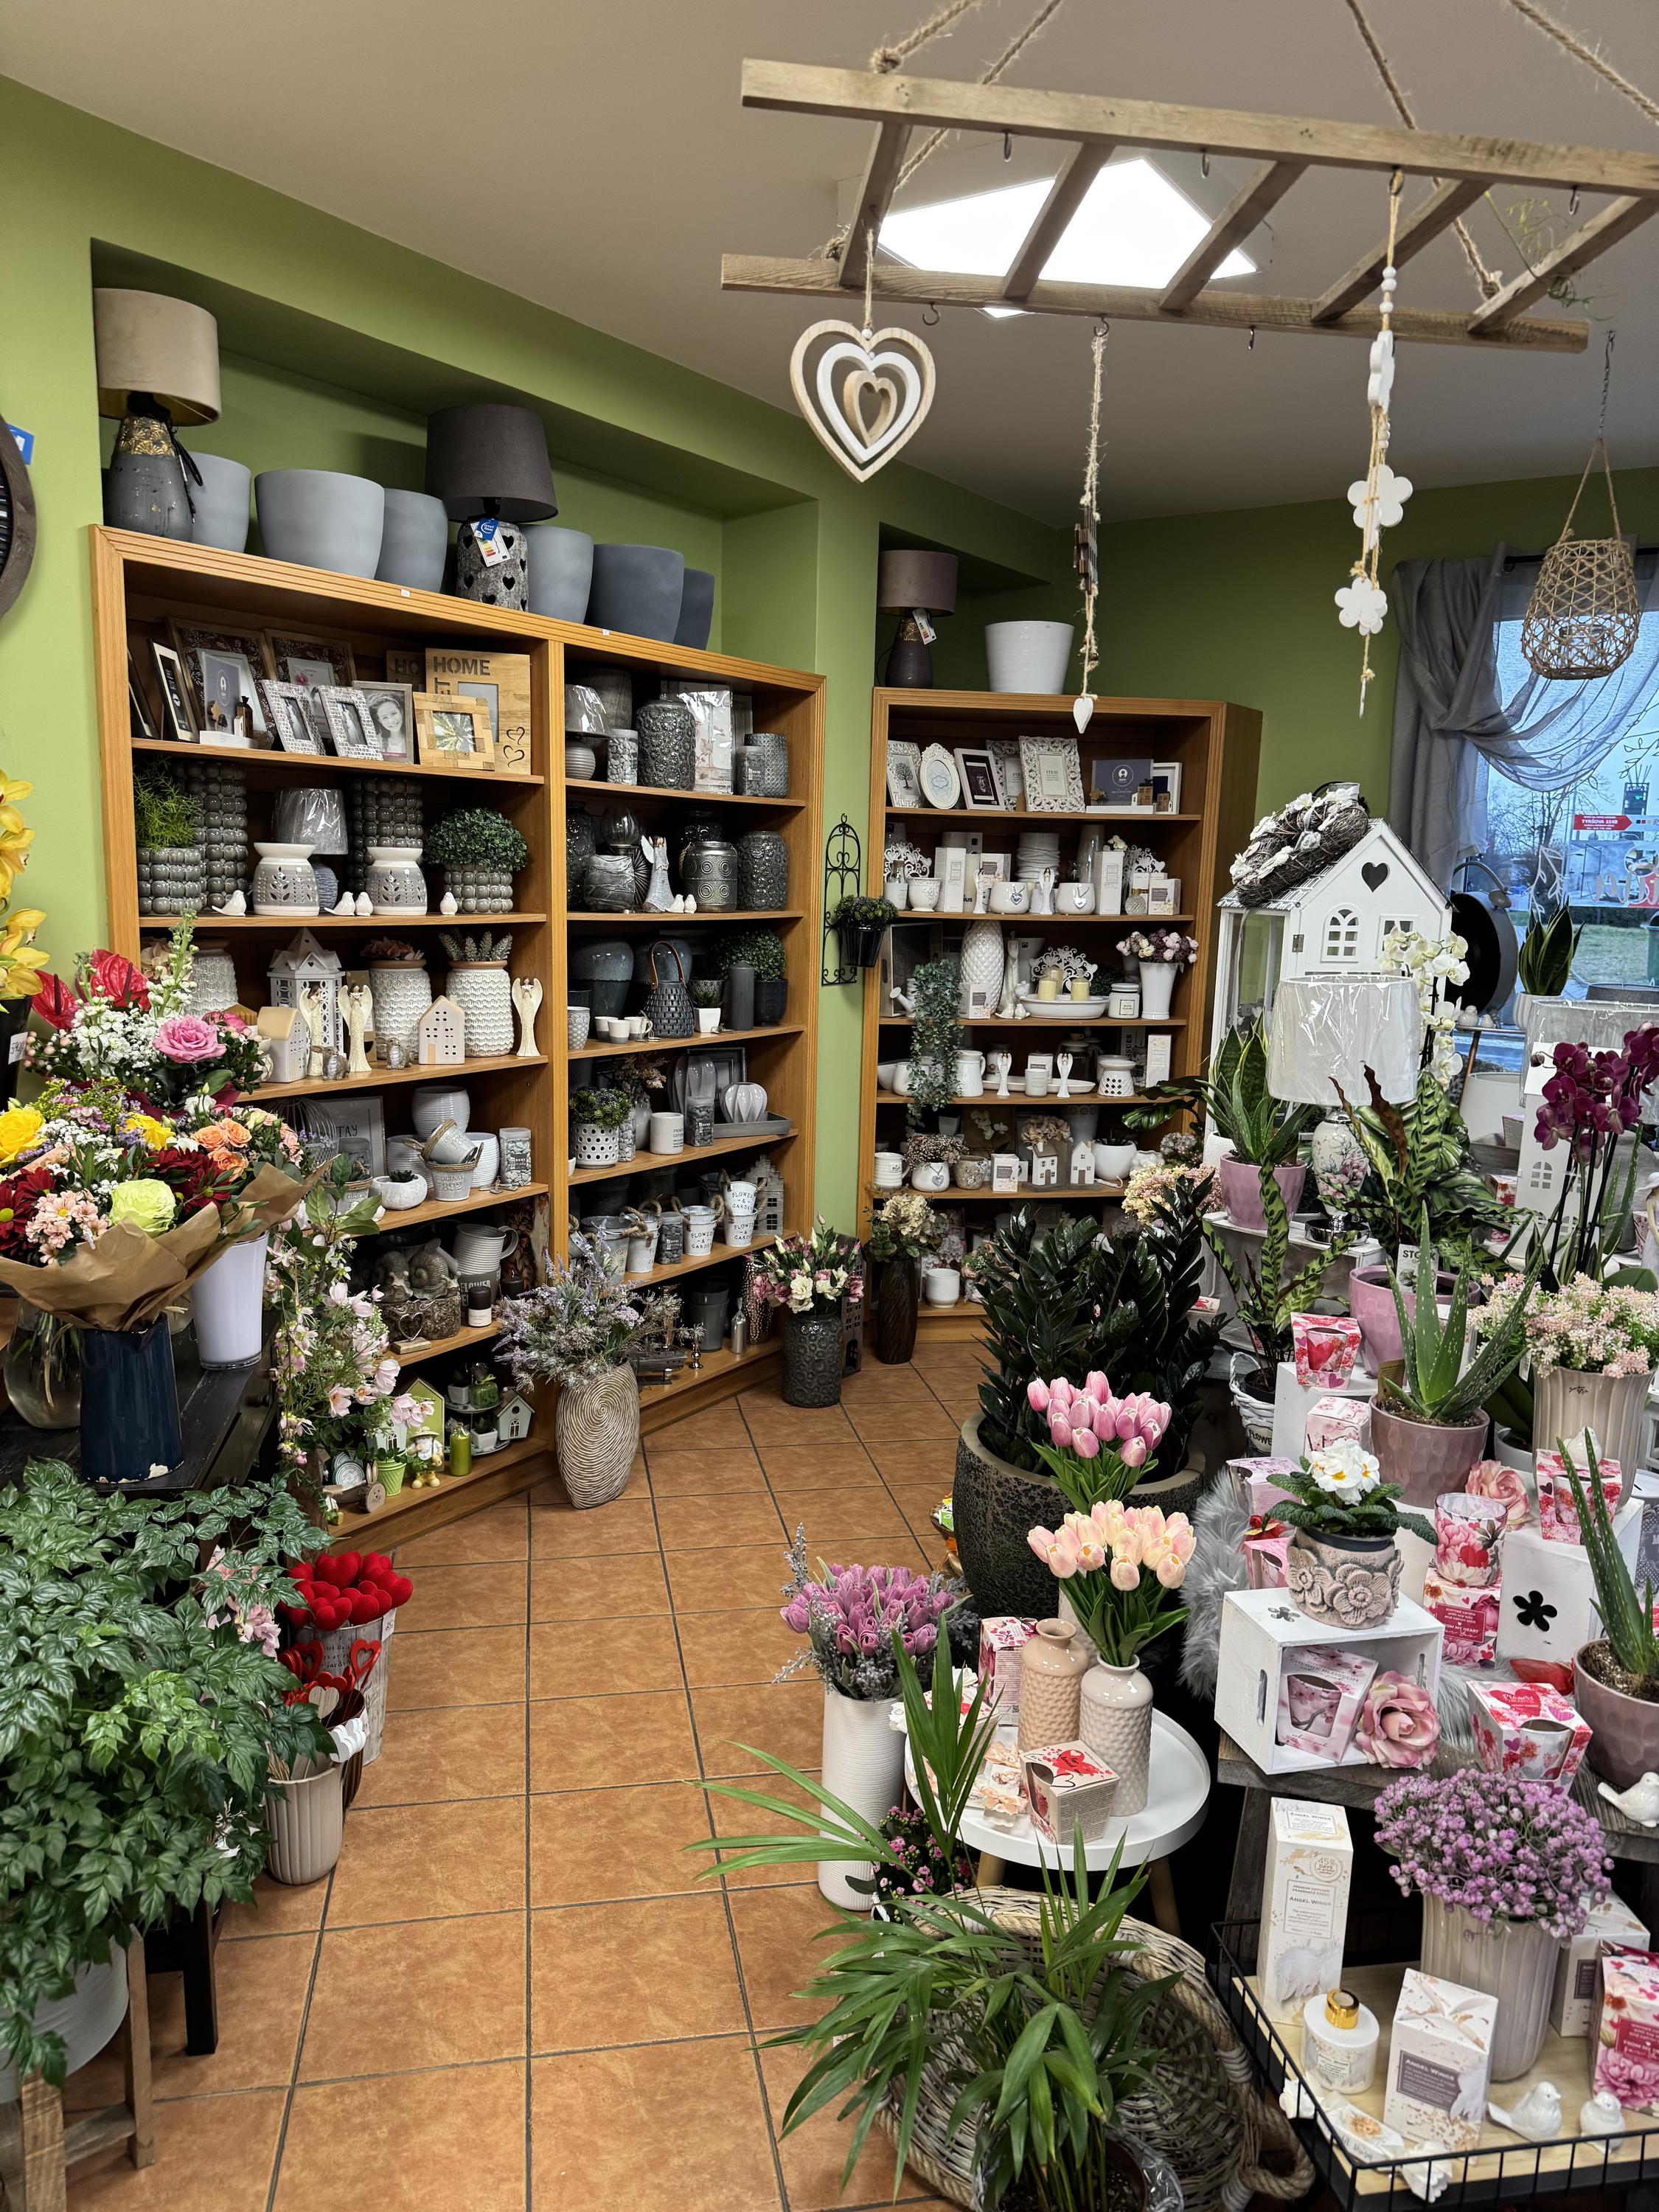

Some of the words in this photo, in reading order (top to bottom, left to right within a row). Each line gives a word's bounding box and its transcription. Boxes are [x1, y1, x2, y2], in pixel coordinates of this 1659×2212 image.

[434, 656, 490, 675] HOME
[1402, 1250, 1436, 1261] STOK
[1248, 1429, 1272, 1446] FLOWE
[1405, 2059, 1429, 2071] ANGEL
[1430, 2068, 1455, 2081] WINGS
